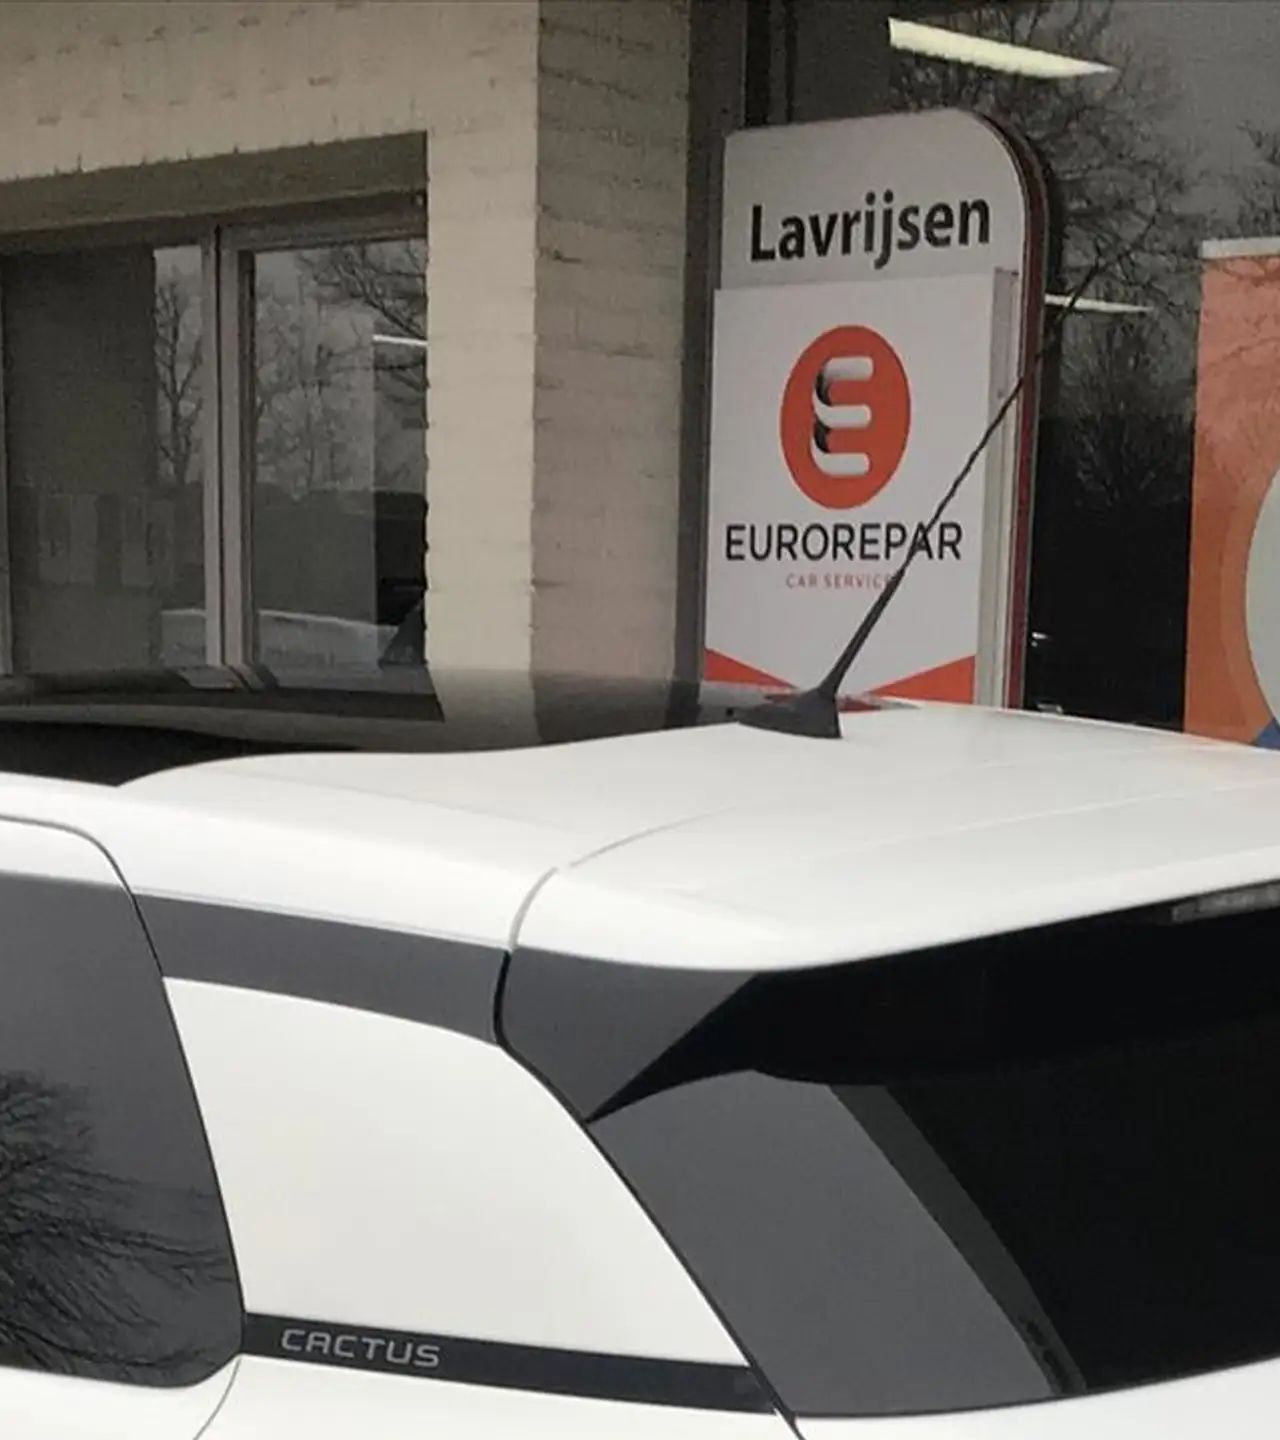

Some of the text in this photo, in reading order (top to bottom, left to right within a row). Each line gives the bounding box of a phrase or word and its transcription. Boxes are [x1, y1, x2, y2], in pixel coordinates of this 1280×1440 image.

[751, 189, 990, 270] Lavrijsen
[725, 522, 963, 562] EUROREPAR
[786, 573, 818, 588] CAR
[281, 1328, 441, 1368] CACTUS
